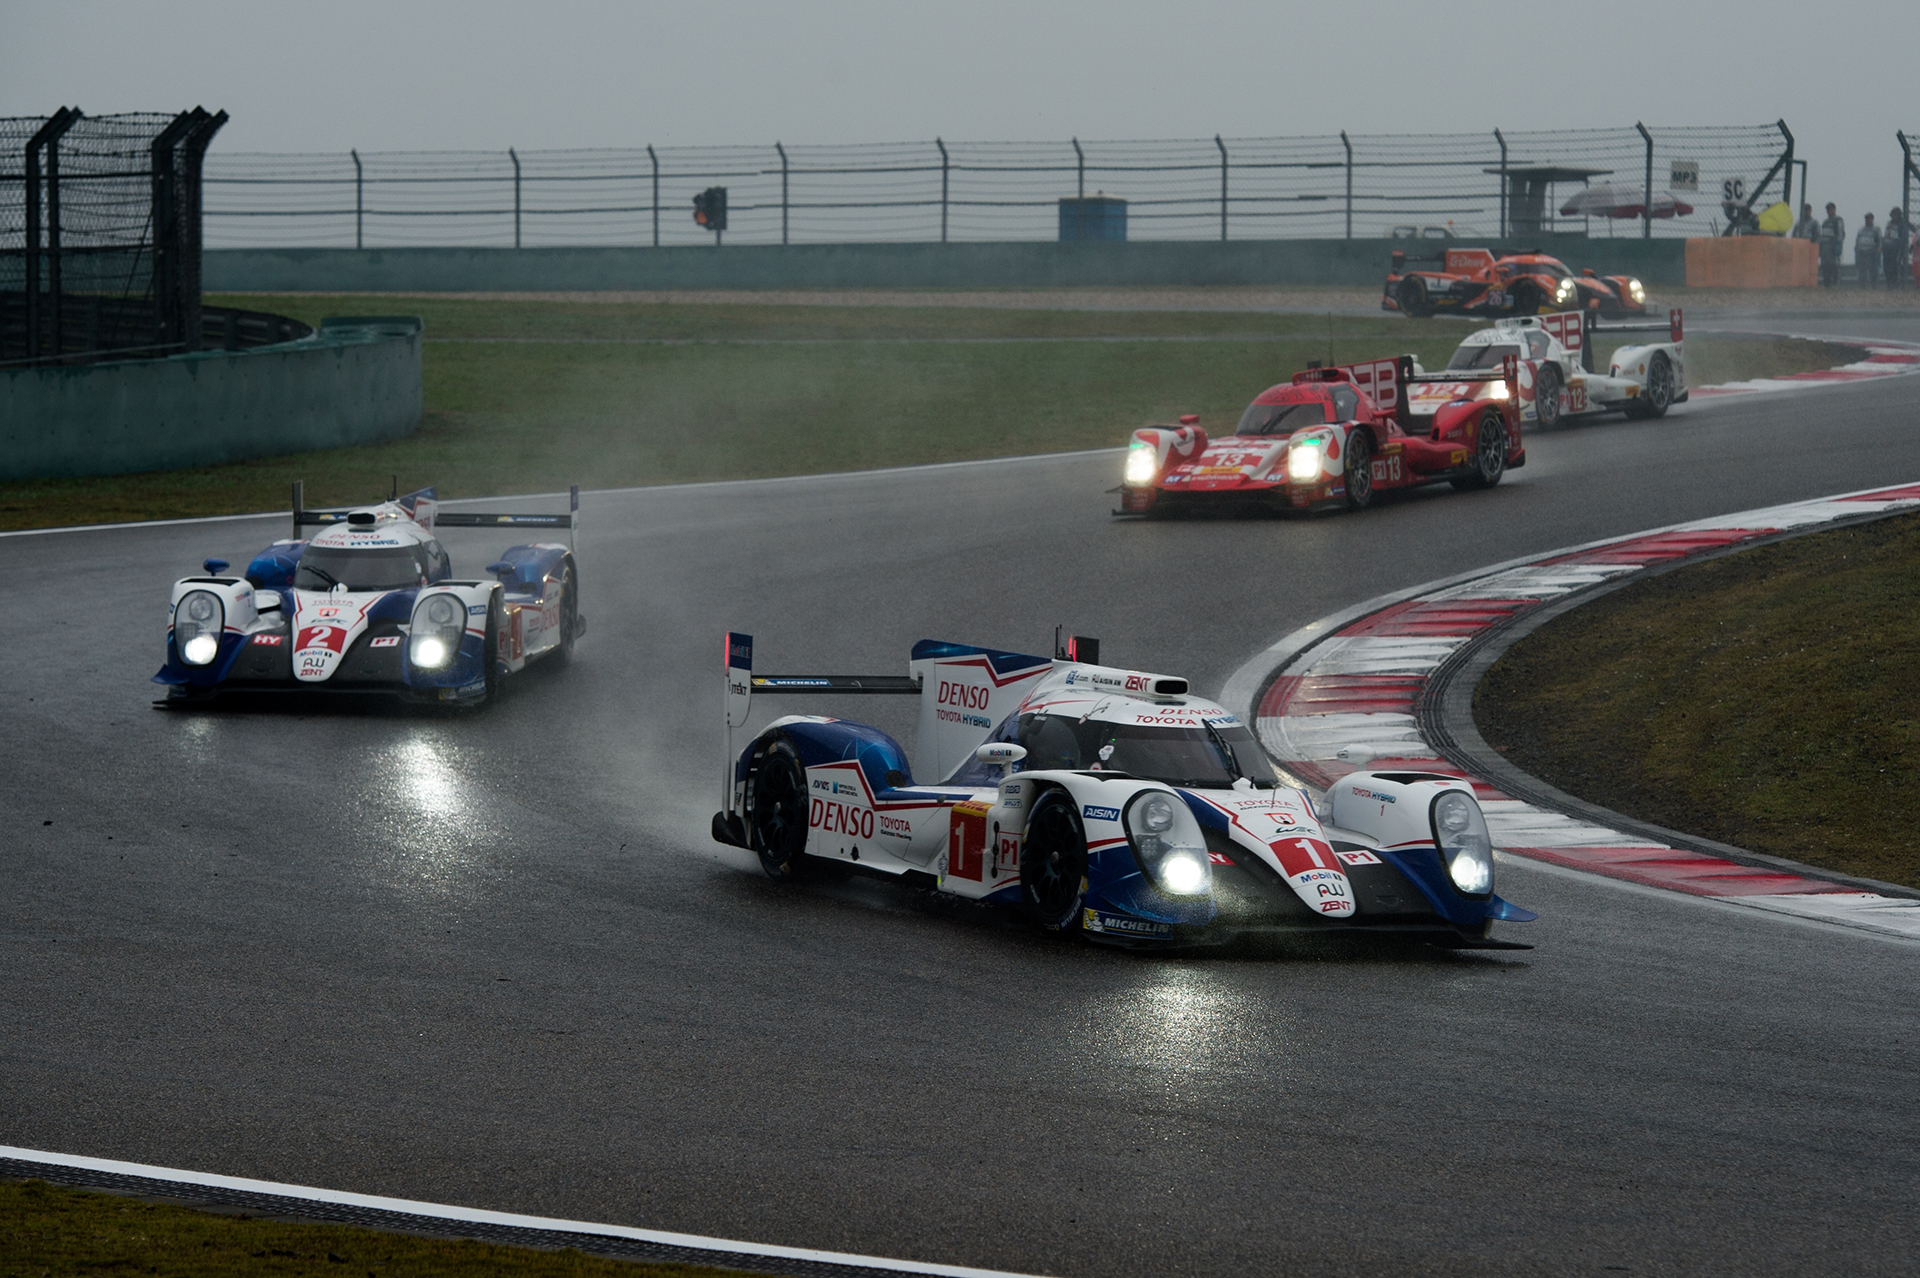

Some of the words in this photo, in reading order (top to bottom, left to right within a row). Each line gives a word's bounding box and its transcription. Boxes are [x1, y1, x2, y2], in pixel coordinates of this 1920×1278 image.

[1724, 180, 1743, 200] SC
[1571, 387, 1583, 409] 12
[1215, 453, 1245, 467] 13
[1387, 455, 1401, 481] 13
[1373, 464, 1385, 479] P1
[254, 635, 281, 645] HY
[306, 626, 332, 648] 2
[300, 669, 324, 677] ZENT
[1125, 675, 1152, 692] ZENT
[938, 681, 990, 710] DENSO
[936, 709, 961, 723] TOYOTA
[962, 714, 991, 729] HYBRID
[1136, 715, 1197, 726] TOYOTA
[989, 749, 1005, 757] Mobil
[1233, 799, 1295, 807] TOYOTA
[1352, 786, 1371, 798] TOYOTA
[1372, 792, 1397, 804] HYBRID
[809, 798, 874, 839] DENSO
[1085, 808, 1118, 819] AISIN
[1380, 804, 1385, 817] 1
[880, 816, 911, 832] TOYOTA
[954, 821, 966, 871] 1
[1001, 838, 1018, 865] P1
[1294, 838, 1326, 868] 1
[1344, 852, 1374, 863] P1
[1300, 872, 1332, 883] Mobil
[1319, 900, 1351, 913] ZENT
[1104, 917, 1171, 934] MICHELIN
